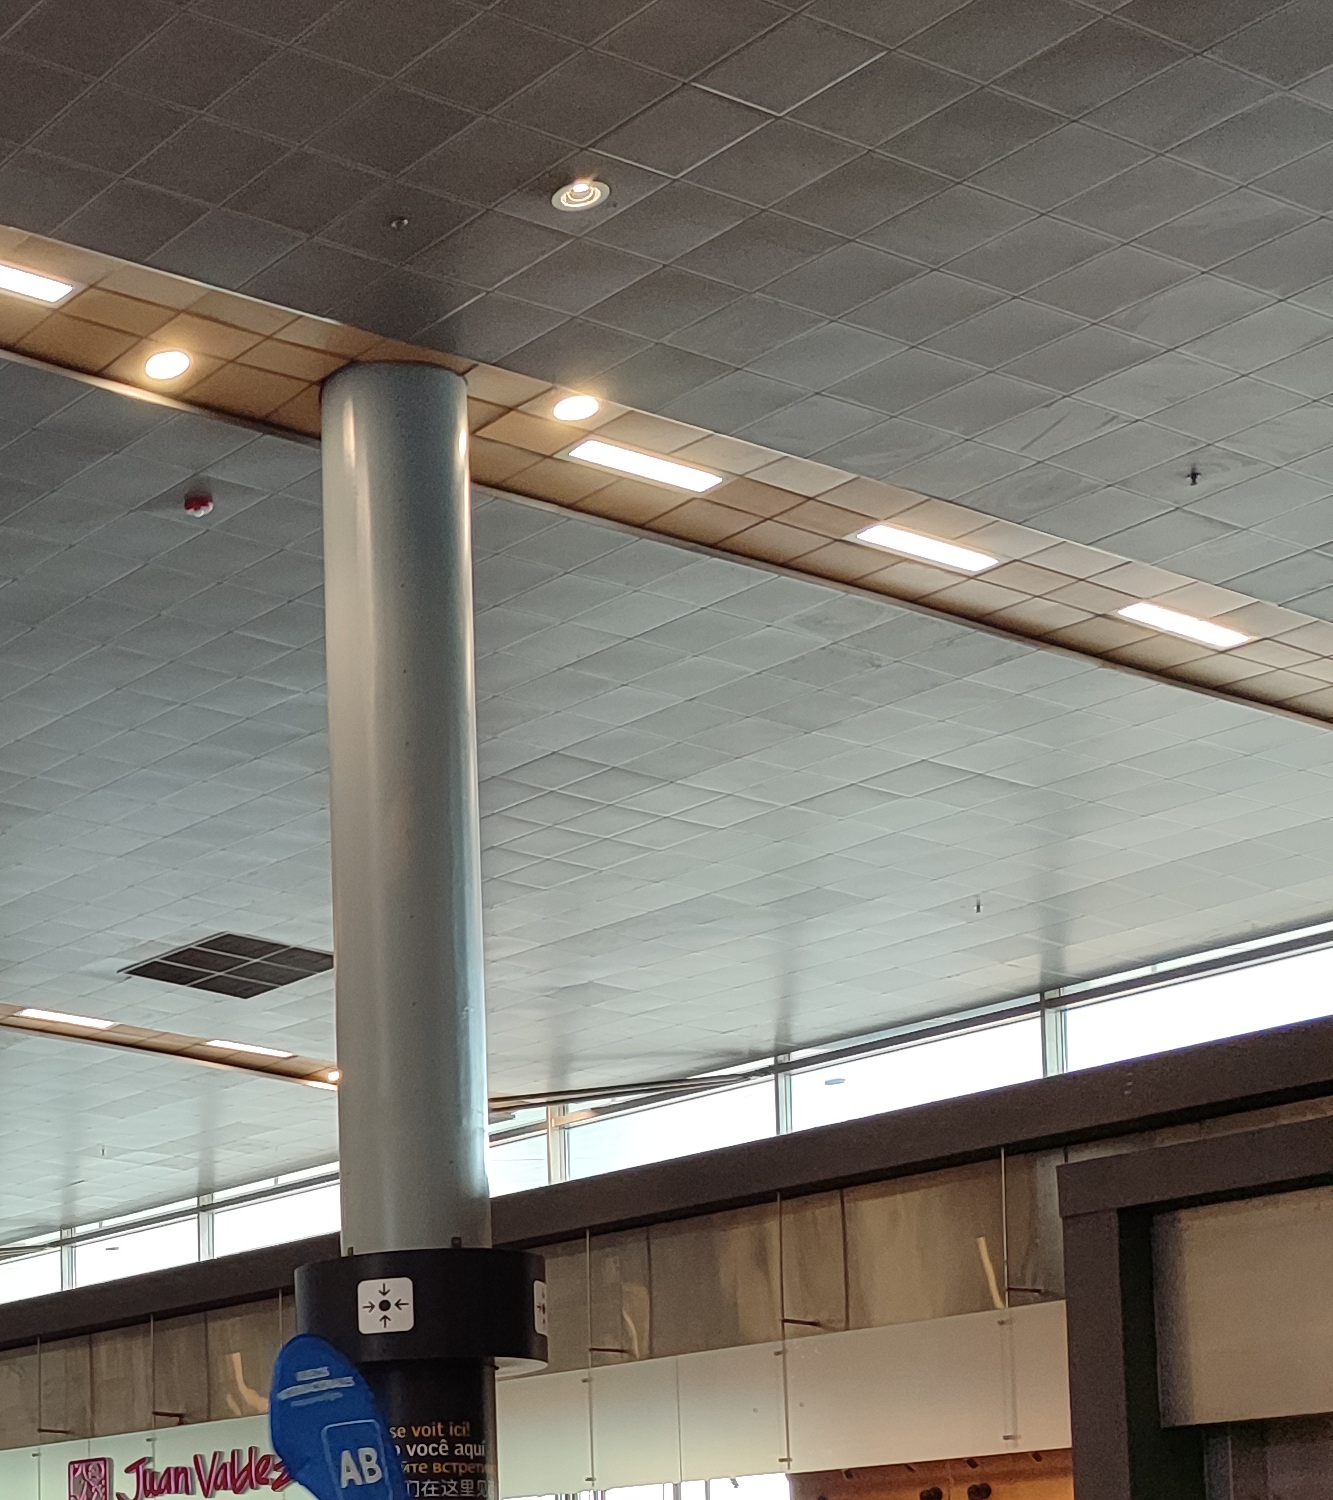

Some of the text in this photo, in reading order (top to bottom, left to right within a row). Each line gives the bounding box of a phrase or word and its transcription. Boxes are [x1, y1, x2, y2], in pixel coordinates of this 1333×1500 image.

[411, 1421, 445, 1437] voit
[405, 1438, 450, 1457] você
[340, 1447, 382, 1489] AB
